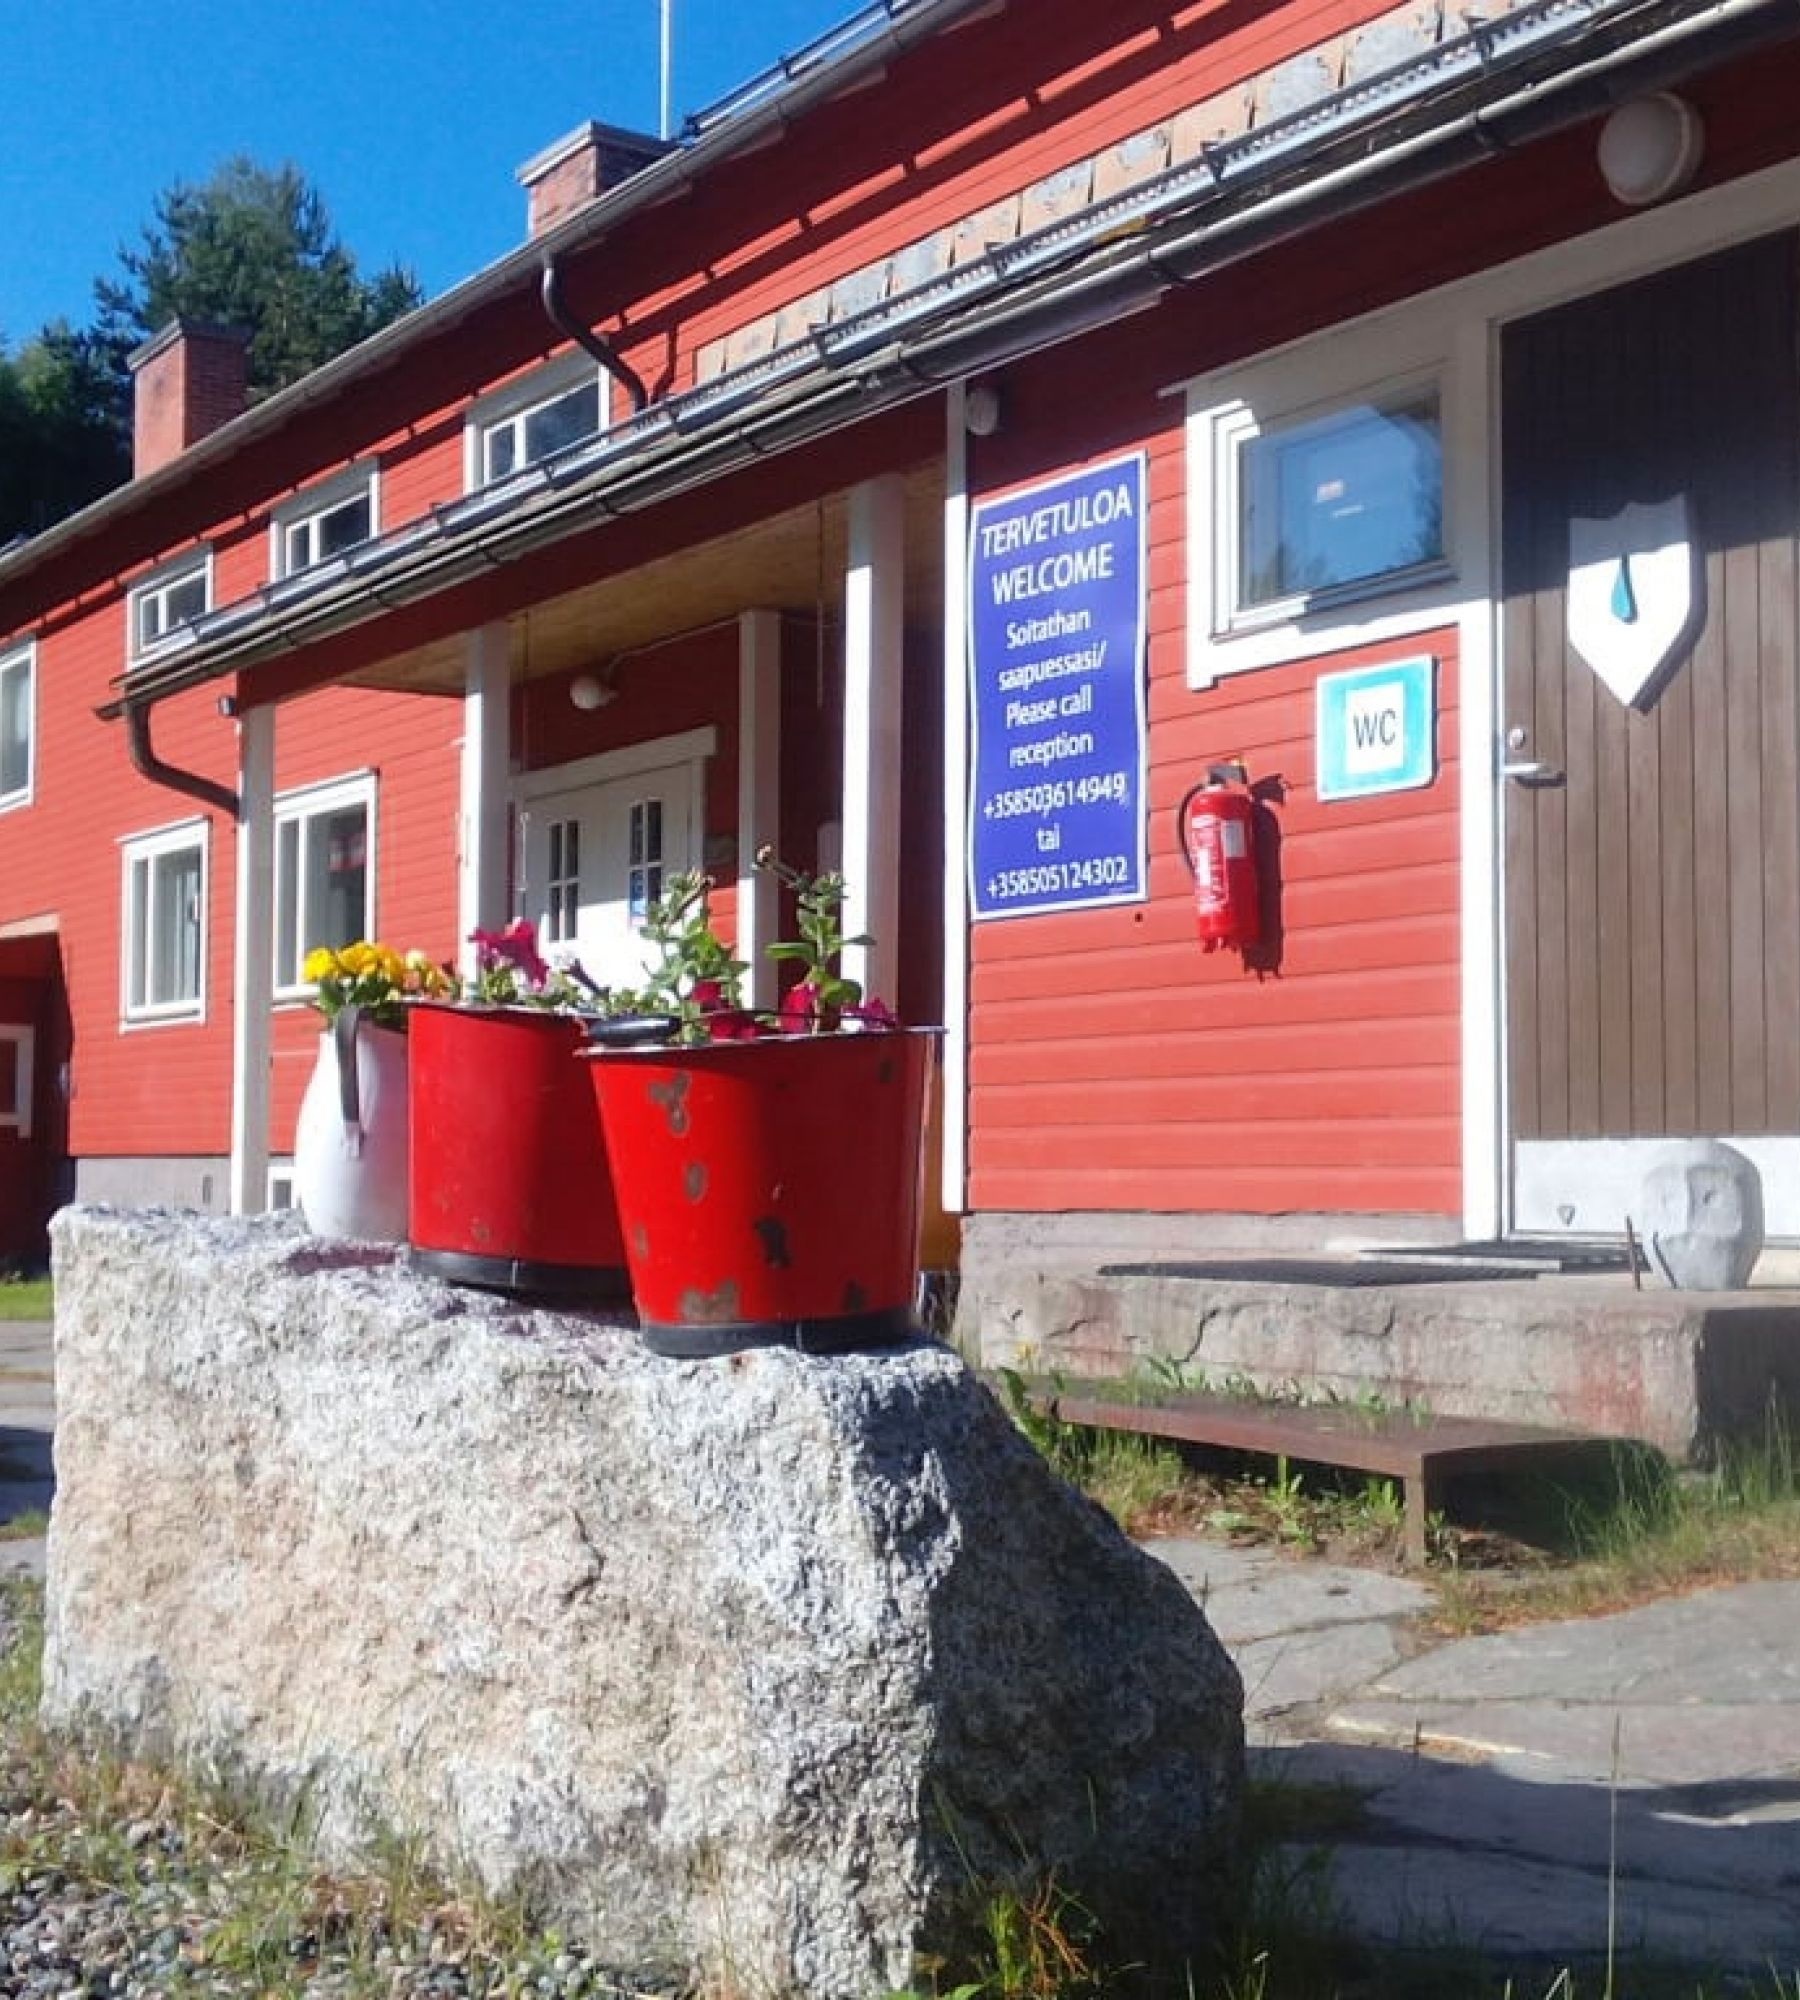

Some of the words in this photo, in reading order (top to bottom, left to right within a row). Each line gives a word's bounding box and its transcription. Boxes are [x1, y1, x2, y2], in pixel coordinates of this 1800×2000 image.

[981, 483, 1132, 558] TERVETULOA
[991, 542, 1114, 605] WELCOME
[1006, 608, 1092, 650] Soitathan
[1006, 699, 1058, 729] Please
[1060, 684, 1092, 716] call
[1353, 708, 1397, 748] WC
[1009, 731, 1094, 768] reception
[1036, 822, 1061, 852] tai
